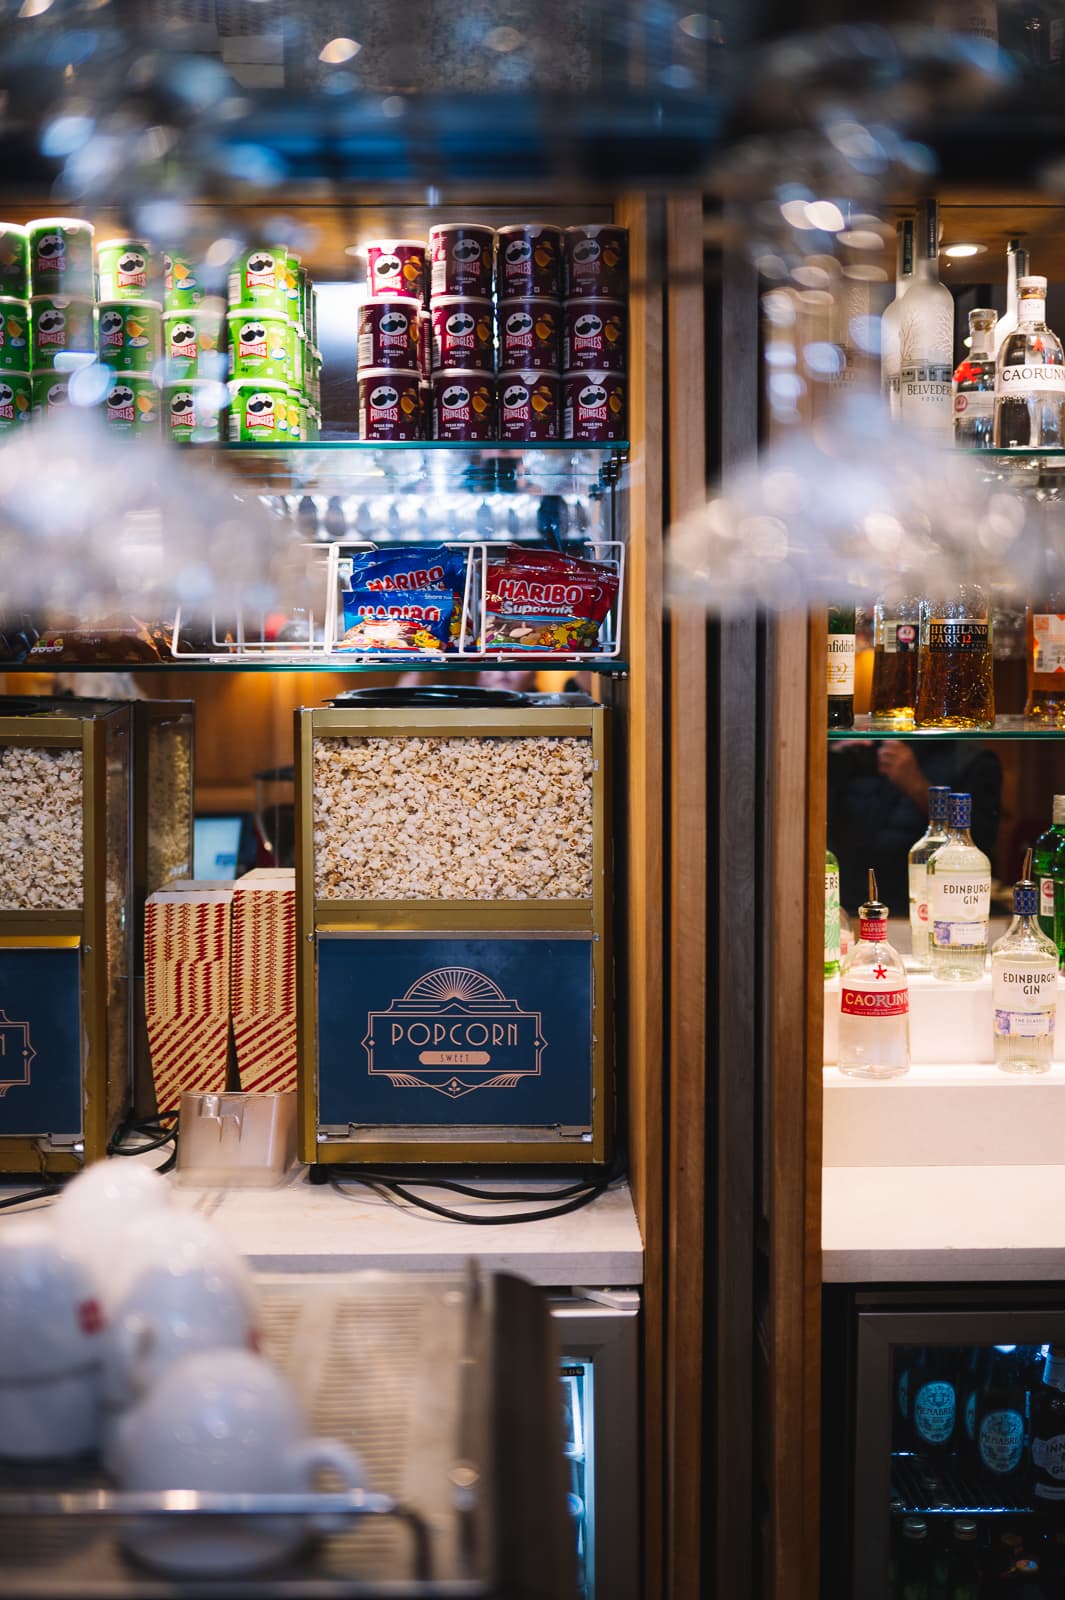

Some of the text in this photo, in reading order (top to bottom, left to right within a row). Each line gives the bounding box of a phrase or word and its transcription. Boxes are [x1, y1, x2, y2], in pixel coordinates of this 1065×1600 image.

[246, 272, 276, 288] PRINGLES
[38, 331, 66, 347] PRINGLES
[379, 334, 408, 349] PRINGLES
[446, 334, 475, 349] PRINGLES
[505, 334, 533, 349] PRINGLES
[574, 335, 602, 351] PRINGLES
[170, 342, 198, 359] PRINGLES
[238, 342, 268, 359] PRINGLES
[170, 412, 197, 428] PRINGLES
[246, 412, 276, 428] PRINGLES
[370, 407, 399, 422] PRINGLES
[442, 407, 470, 422] PRINGLES
[503, 406, 529, 422] PRINGLES
[578, 406, 608, 422] PRINGLES
[366, 566, 444, 592] HARIBO
[498, 578, 584, 604] HARIBO
[930, 625, 988, 635] HIGHLAND
[930, 634, 972, 645] PARK 12
[963, 896, 979, 904] GIN
[1023, 985, 1041, 995] GIN
[391, 1022, 519, 1047] POPCORN
[440, 1054, 470, 1063] SWEET
